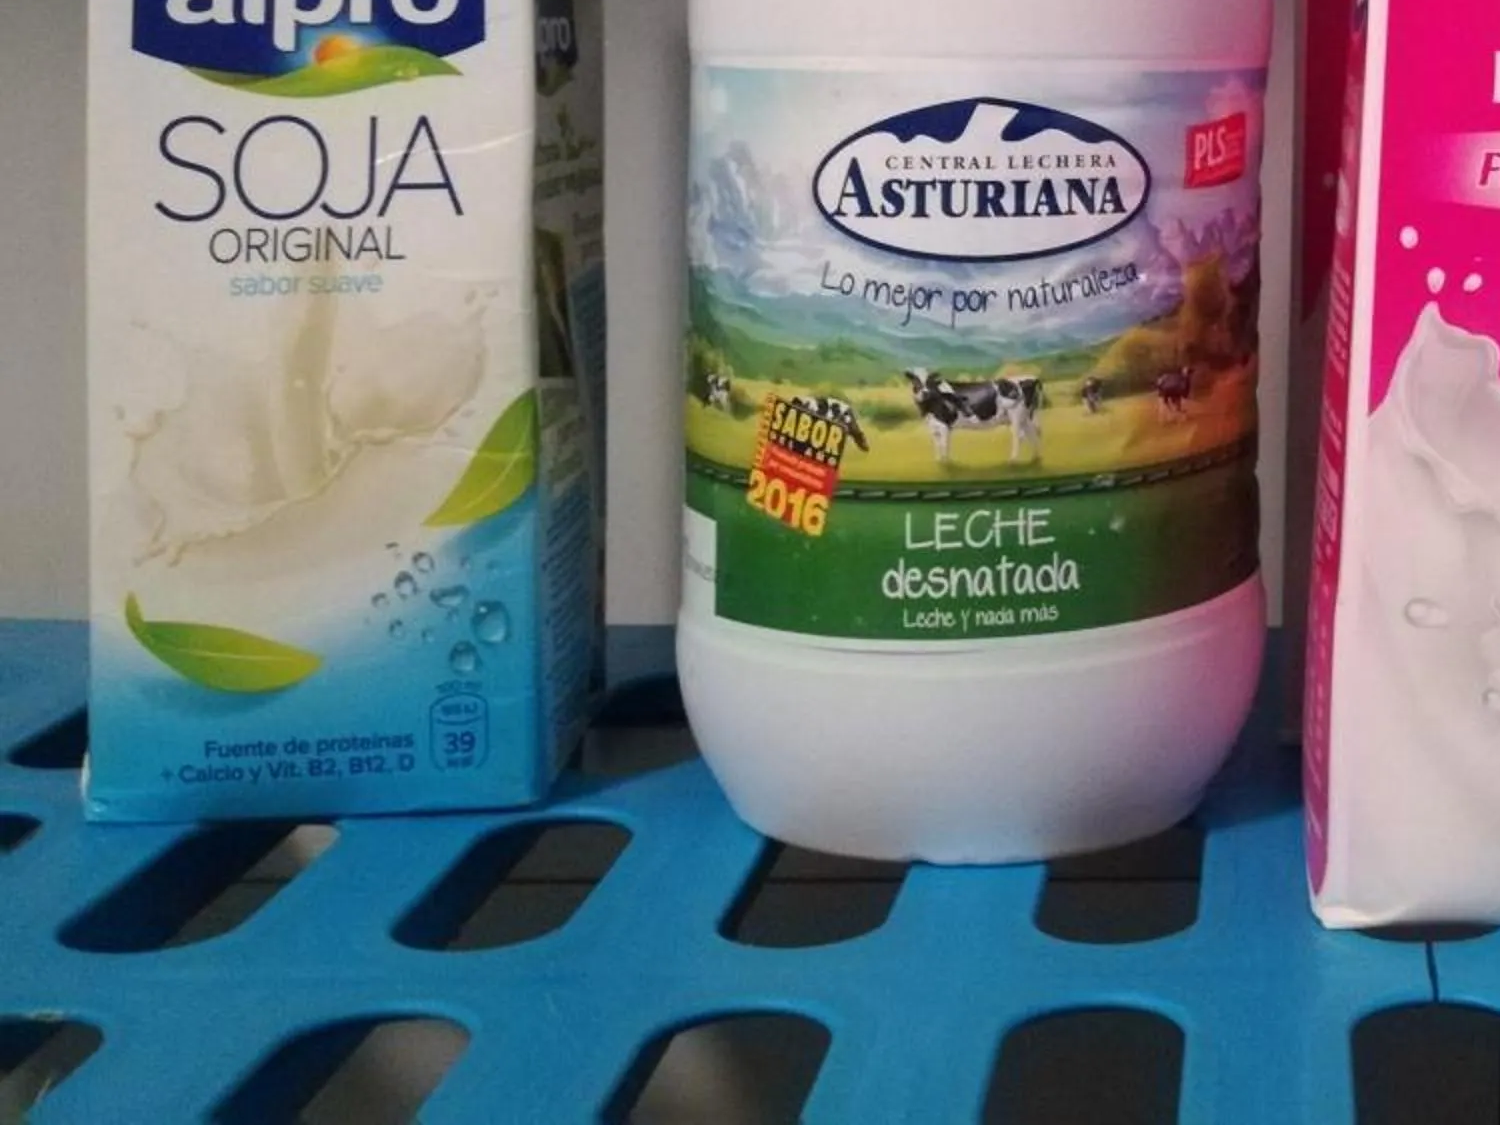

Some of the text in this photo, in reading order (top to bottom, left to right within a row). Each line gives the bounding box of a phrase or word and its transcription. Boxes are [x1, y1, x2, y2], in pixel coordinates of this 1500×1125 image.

[155, 115, 464, 222] SOJA
[886, 153, 1118, 171] CENTRAL LECHERA
[1194, 125, 1226, 170] PLS
[834, 157, 1127, 220] ASTURIANA
[208, 225, 406, 265] ORIGINAL
[230, 274, 383, 297] sabor suave
[822, 261, 1138, 328] Lo mejor por naturaleza
[772, 402, 843, 455] SABOR
[746, 468, 829, 537] 2016
[905, 509, 1056, 551] LECHE
[882, 554, 1080, 600] desnatada
[903, 607, 955, 630] Leche
[975, 605, 1015, 627] nada
[1021, 603, 1059, 624] más
[204, 740, 278, 759] Fuente
[283, 736, 309, 754] de
[443, 731, 477, 755] 39
[178, 764, 245, 785] Calcio
[247, 767, 262, 784] y
[309, 759, 343, 779] B2,
[401, 755, 415, 772] D
